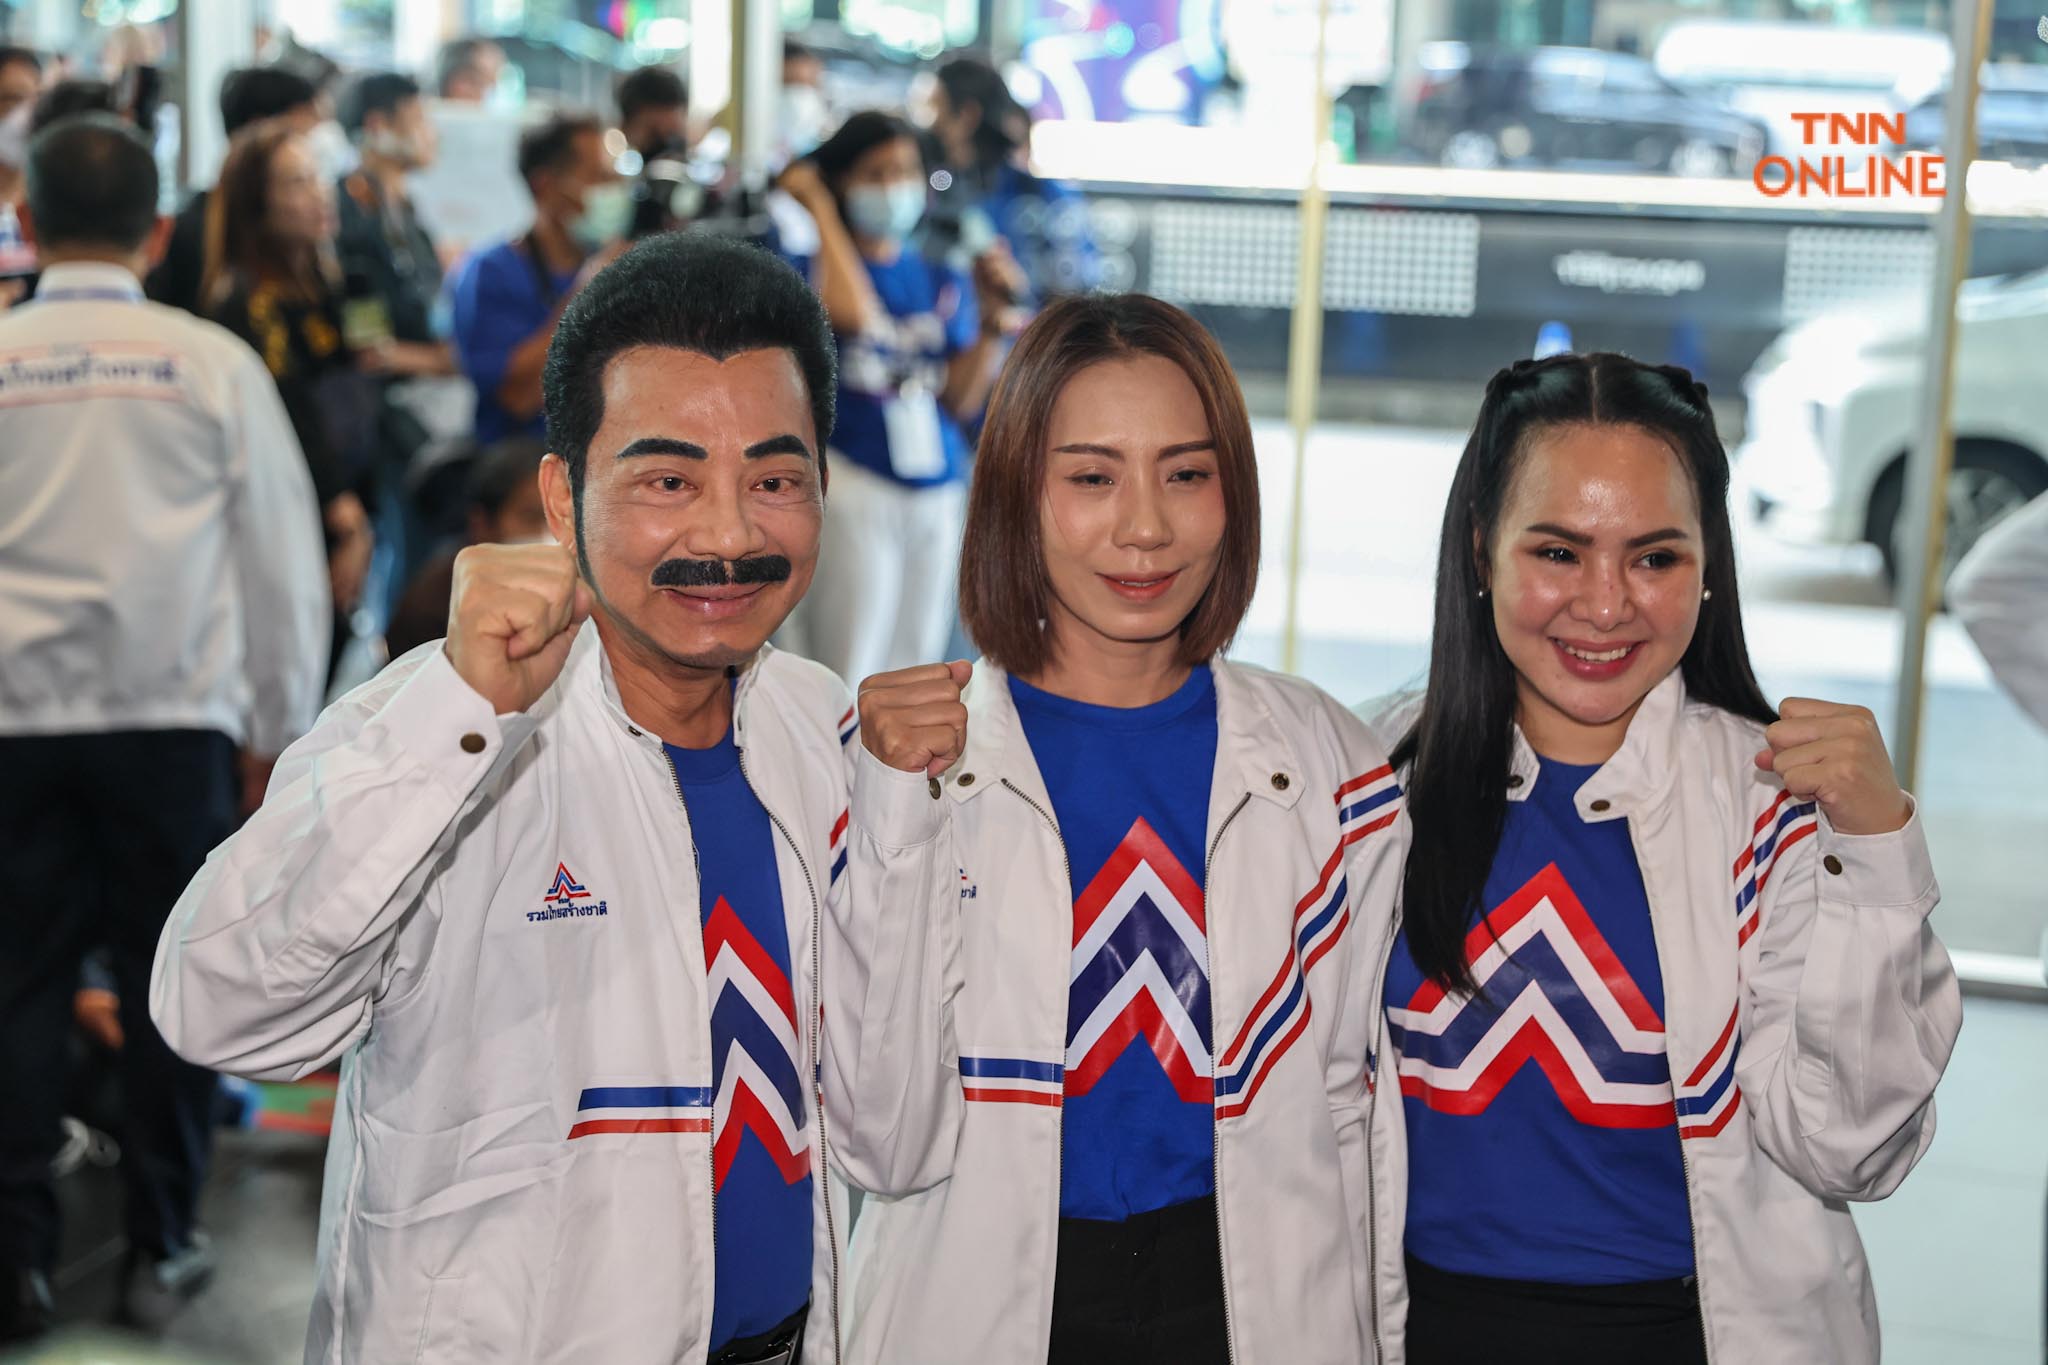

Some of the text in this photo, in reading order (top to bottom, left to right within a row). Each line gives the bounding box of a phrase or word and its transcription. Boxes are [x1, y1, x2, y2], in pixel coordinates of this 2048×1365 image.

[526, 900, 608, 922] รวมไทยสร้างชาติ
